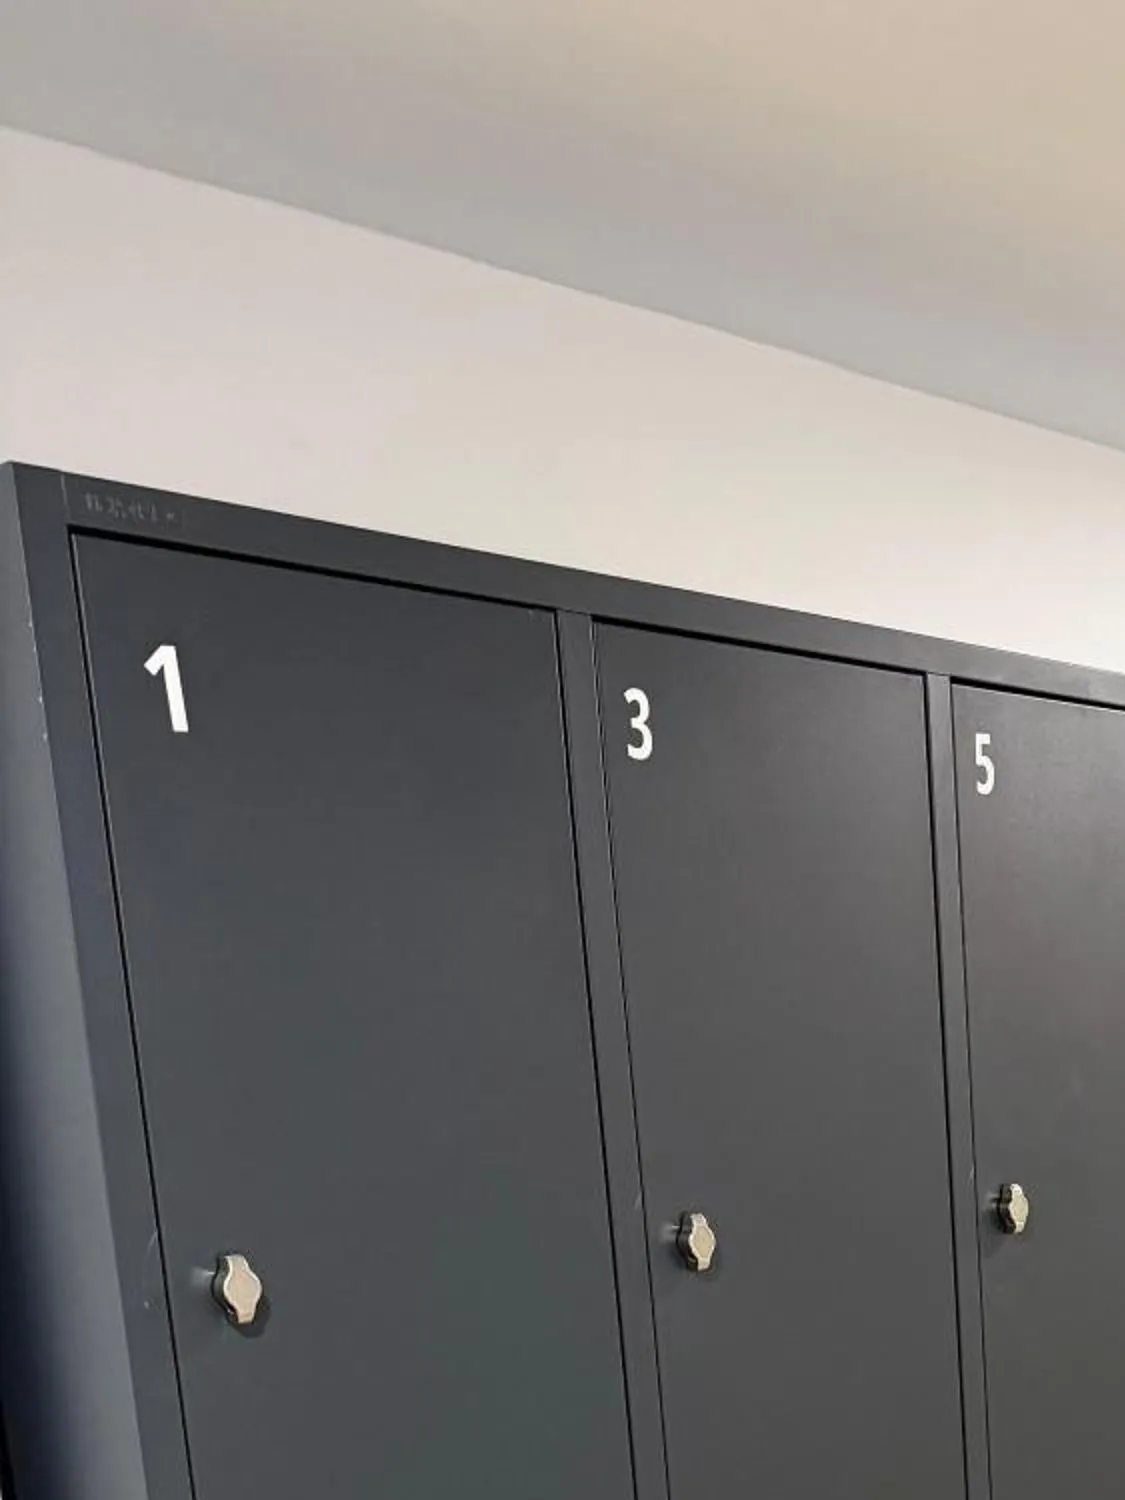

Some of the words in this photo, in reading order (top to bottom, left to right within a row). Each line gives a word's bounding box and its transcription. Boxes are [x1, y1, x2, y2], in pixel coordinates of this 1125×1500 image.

[143, 644, 189, 733] 1
[623, 687, 653, 761] 3
[975, 732, 996, 797] 5
